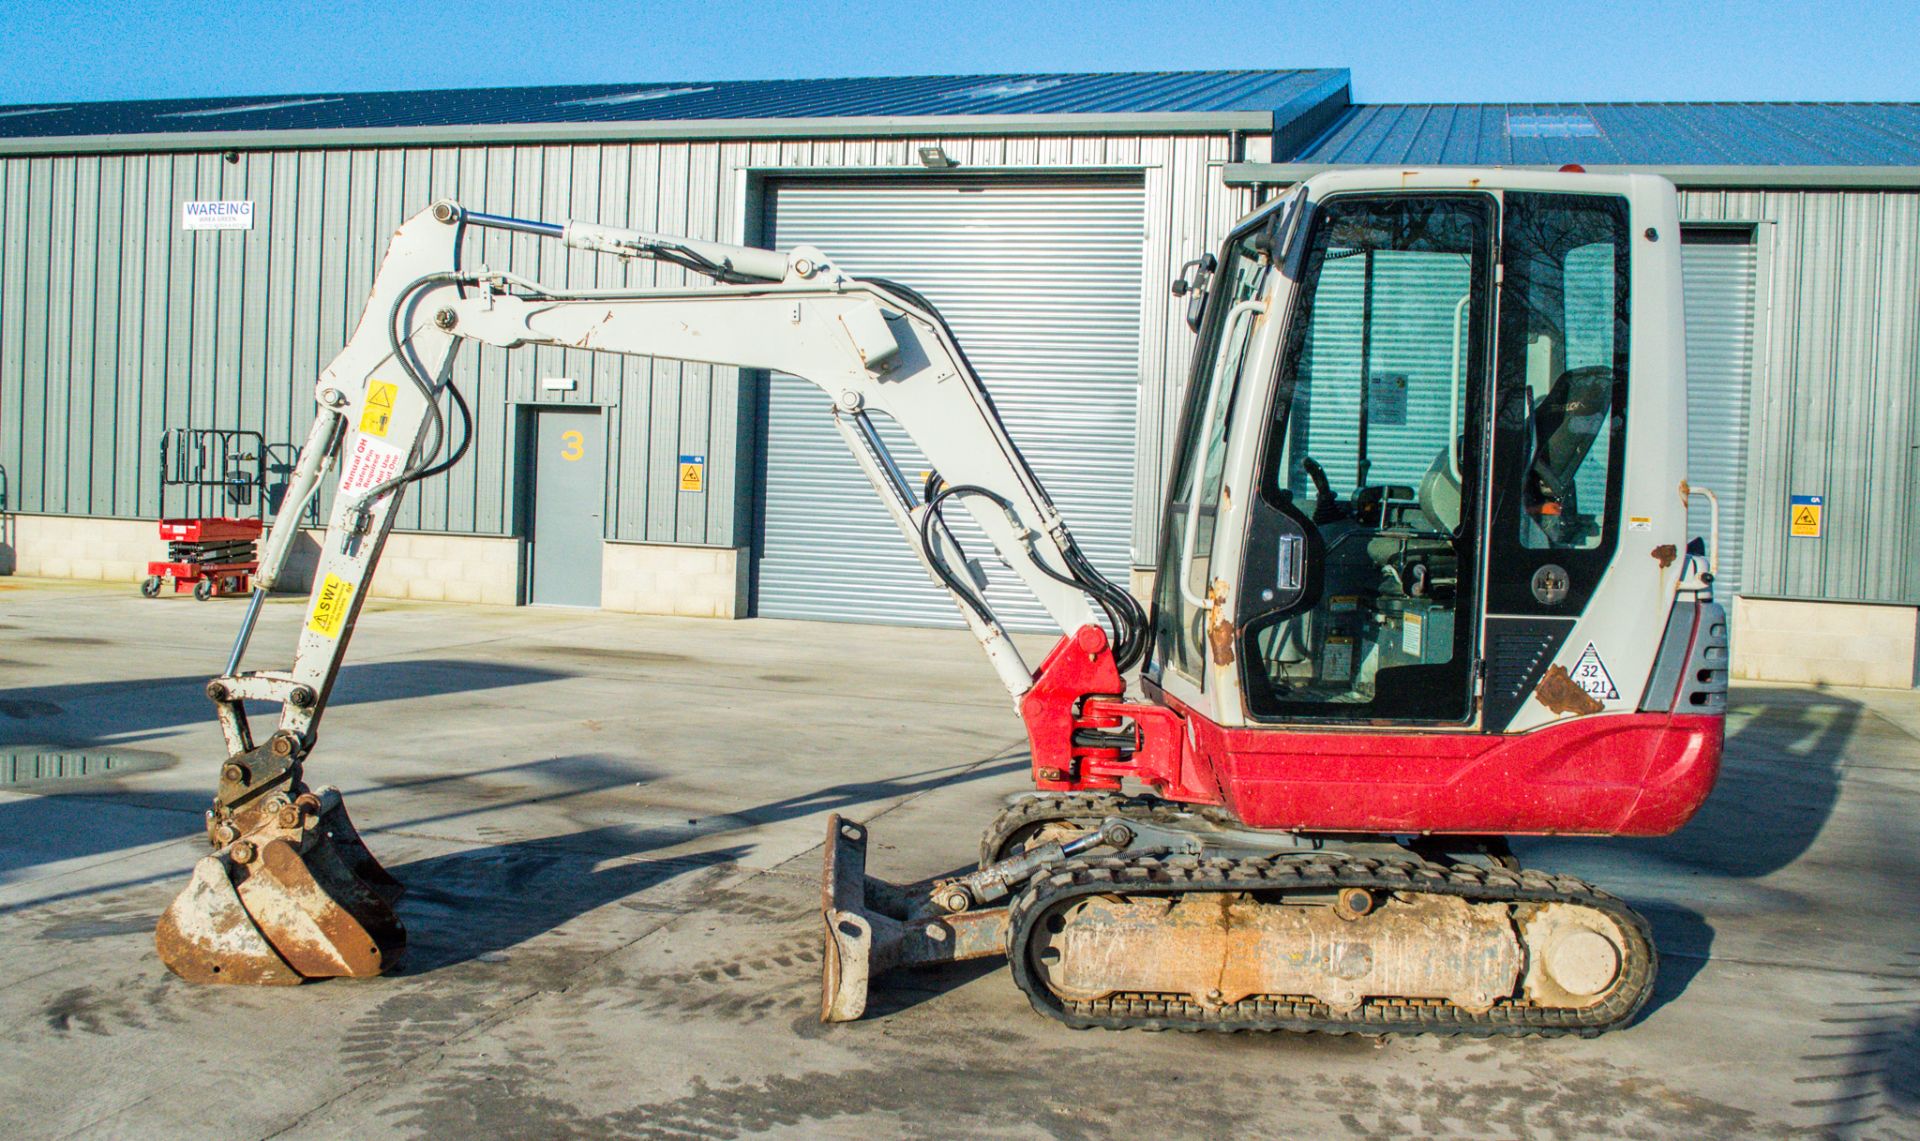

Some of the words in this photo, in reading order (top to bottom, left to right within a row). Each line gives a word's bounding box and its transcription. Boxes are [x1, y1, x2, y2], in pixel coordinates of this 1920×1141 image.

[187, 203, 250, 215] WAREING
[560, 430, 584, 462] 3
[343, 455, 361, 491] Manual
[357, 438, 368, 453] QH
[356, 462, 370, 488] Safety
[365, 449, 374, 462] Pin
[363, 454, 380, 488] Required
[376, 470, 385, 484] Not
[382, 454, 391, 469] Use
[388, 454, 399, 470] One
[320, 582, 339, 611] SWL
[1581, 665, 1598, 677] 32
